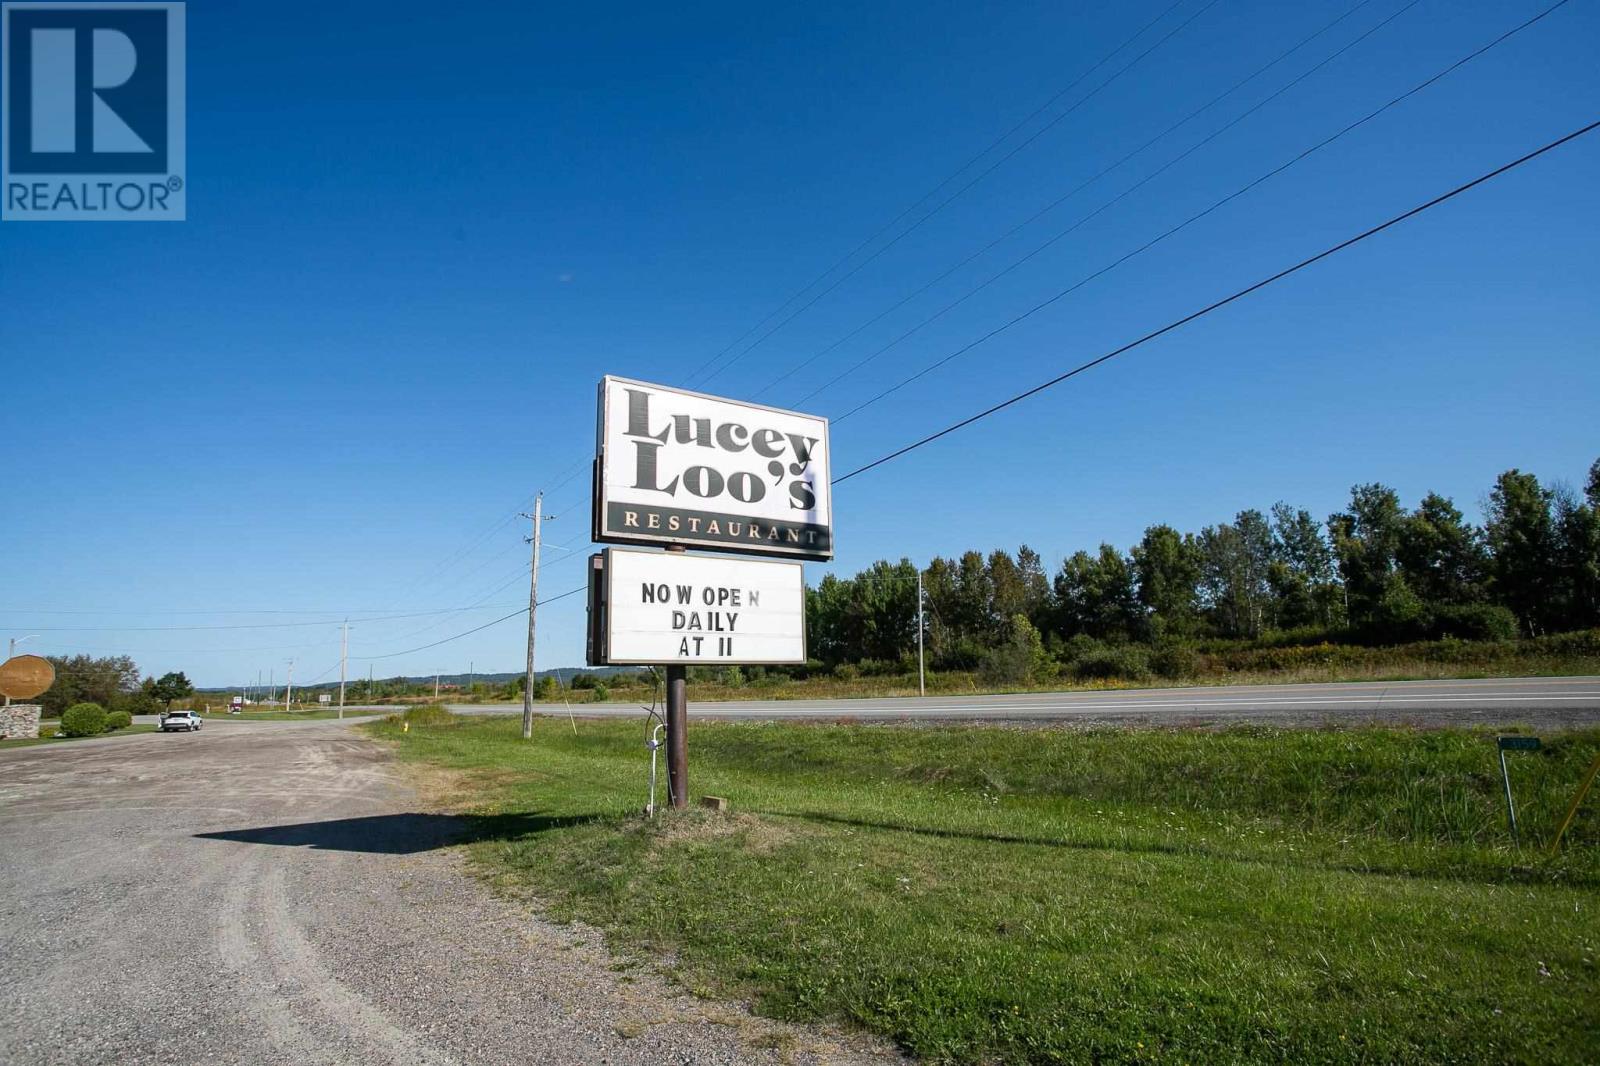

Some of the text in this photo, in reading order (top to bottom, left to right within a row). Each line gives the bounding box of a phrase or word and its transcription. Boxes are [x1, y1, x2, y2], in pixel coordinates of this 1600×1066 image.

[623, 388, 819, 475] Lucey
[630, 440, 816, 510] Loo's
[624, 511, 818, 543] RESTAURANT
[641, 583, 760, 607] NOW OPEN
[672, 610, 739, 632] DAILY
[679, 636, 704, 656] AT
